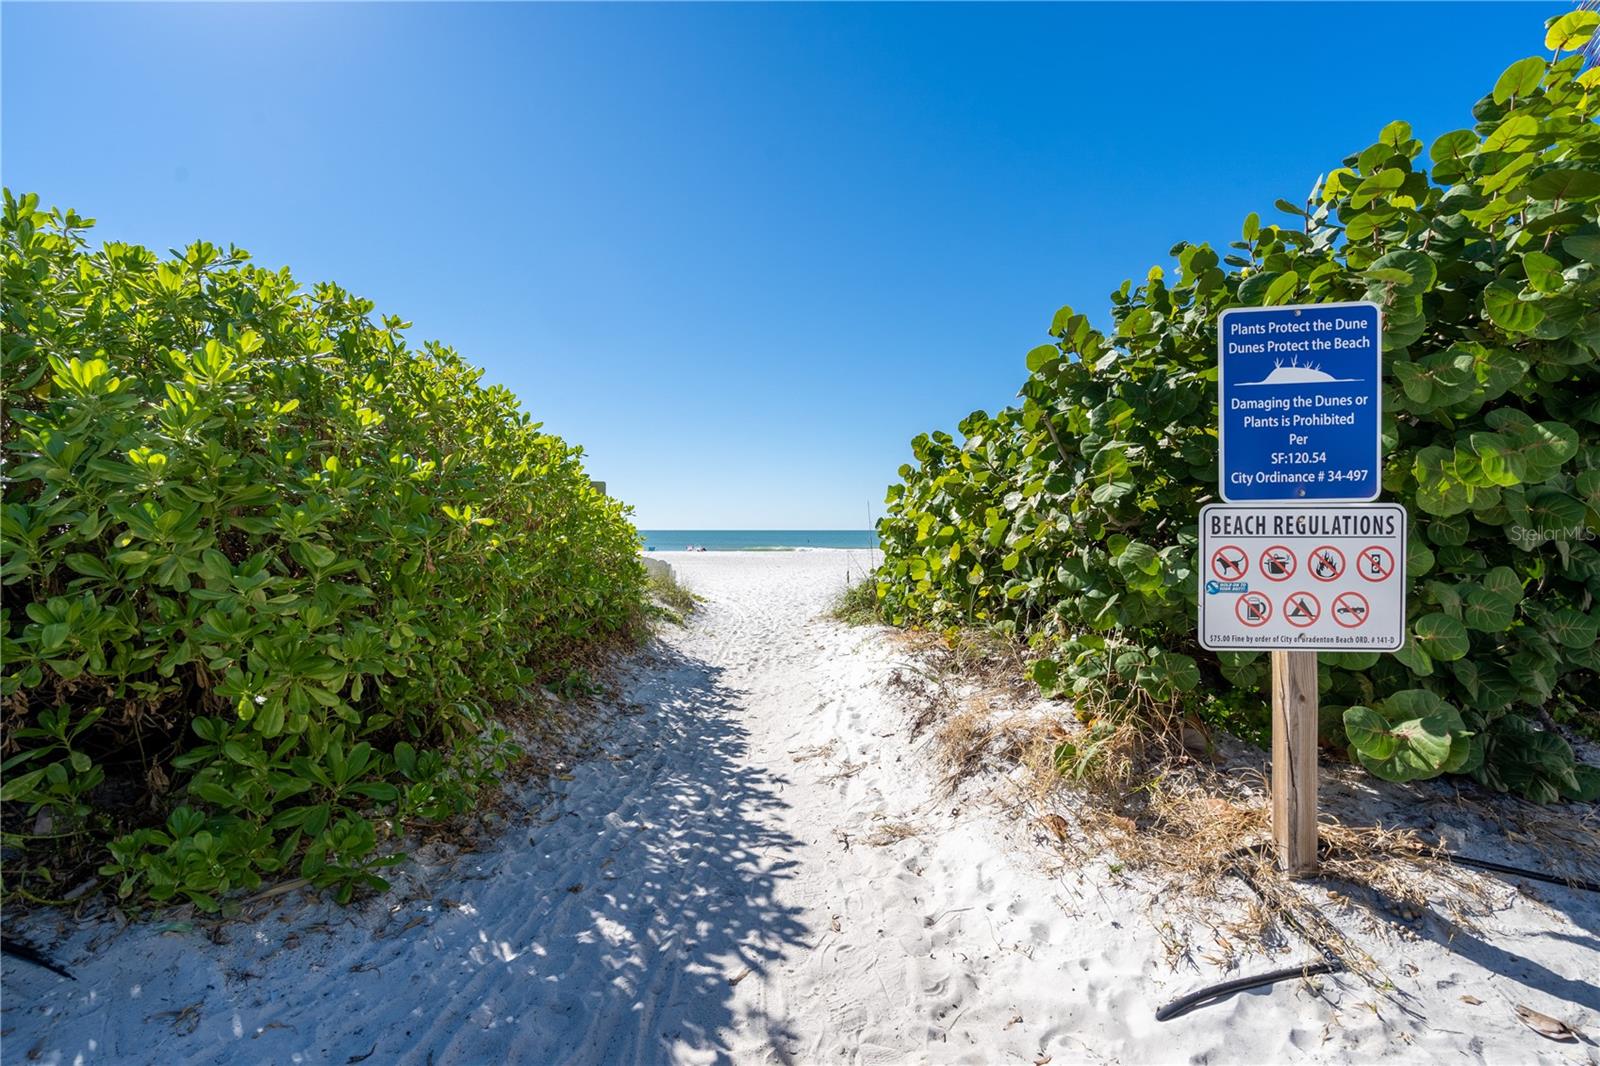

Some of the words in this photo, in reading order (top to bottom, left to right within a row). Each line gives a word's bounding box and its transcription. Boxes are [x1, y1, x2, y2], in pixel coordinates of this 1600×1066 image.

[1231, 323, 1265, 335] Plants
[1269, 321, 1310, 333] Protect
[1313, 320, 1332, 331] the
[1335, 318, 1368, 330] Dune
[1229, 342, 1264, 354] Dunes
[1268, 340, 1309, 352] Protect
[1312, 339, 1331, 350] the
[1335, 337, 1370, 349] Beach
[1232, 398, 1290, 411] Damaging
[1293, 396, 1312, 407] the
[1315, 395, 1352, 406] Dunes
[1356, 395, 1368, 405] or
[1244, 416, 1278, 428] Plants
[1282, 415, 1290, 426] is
[1294, 413, 1354, 426] Prohibited
[1289, 434, 1308, 445] Per
[1271, 452, 1326, 464] SF:120.54
[1231, 473, 1253, 486] City
[1256, 471, 1315, 483] Ordinance
[1319, 471, 1324, 482] #
[1328, 470, 1368, 482] 34-497
[1211, 515, 1266, 534] BEACH
[1274, 515, 1395, 535] REGULATIONS
[1246, 635, 1253, 643] by
[1280, 636, 1292, 644] City
